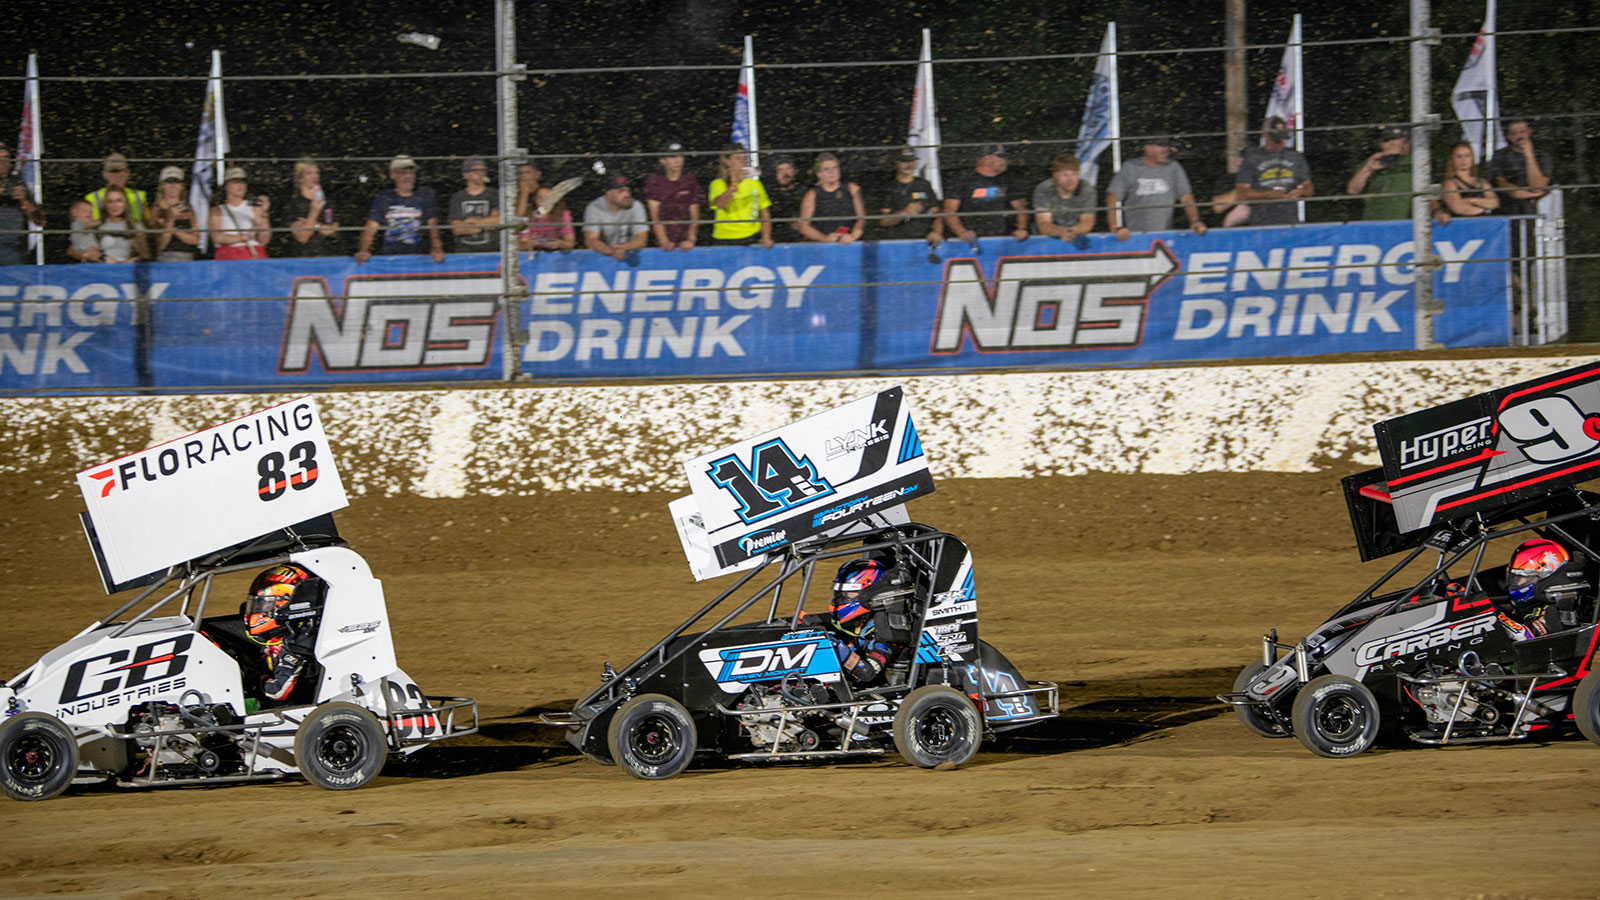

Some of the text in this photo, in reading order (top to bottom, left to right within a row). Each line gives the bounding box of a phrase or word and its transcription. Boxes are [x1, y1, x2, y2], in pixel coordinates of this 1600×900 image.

[531, 265, 826, 316] ENERGY
[1182, 239, 1484, 296] ENERGY
[278, 275, 503, 373] NOS
[930, 250, 1165, 354] NOS
[1172, 289, 1408, 341] DRINK
[522, 314, 753, 363] DRINK
[118, 403, 314, 491] FLORACING
[825, 419, 888, 457] LYNK
[1400, 416, 1492, 470] Hyper
[1450, 439, 1493, 456] RACING
[257, 440, 318, 502] 83
[704, 436, 837, 526] 14
[740, 529, 787, 557] Premier
[58, 633, 195, 705] CB
[730, 643, 818, 676] DM
[1370, 636, 1485, 673] RACING
